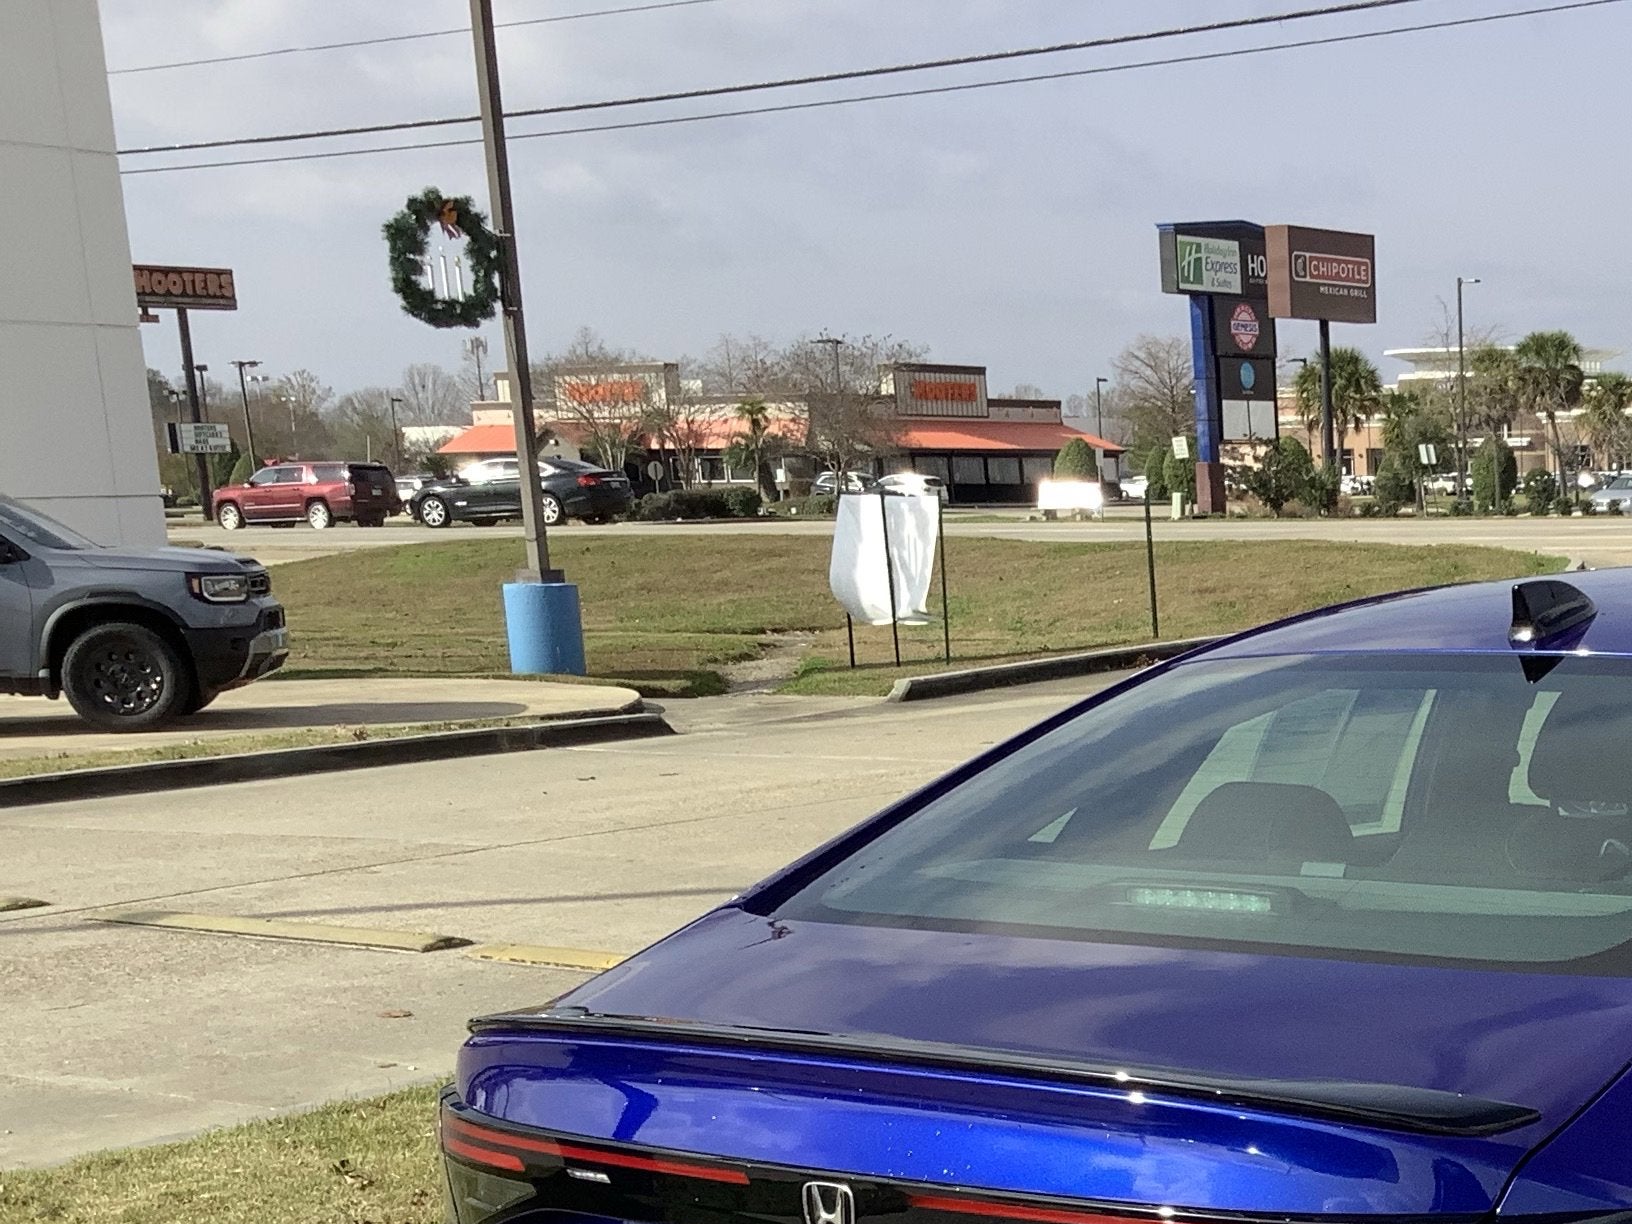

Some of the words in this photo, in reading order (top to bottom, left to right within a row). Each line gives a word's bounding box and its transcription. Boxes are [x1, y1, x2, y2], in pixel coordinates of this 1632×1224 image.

[1205, 256, 1238, 276] Express
[1310, 260, 1368, 280] CHIPOTLE
[133, 270, 234, 298] HOOTERS
[1320, 286, 1348, 296] MEXICAN
[1349, 288, 1368, 298] GRILL
